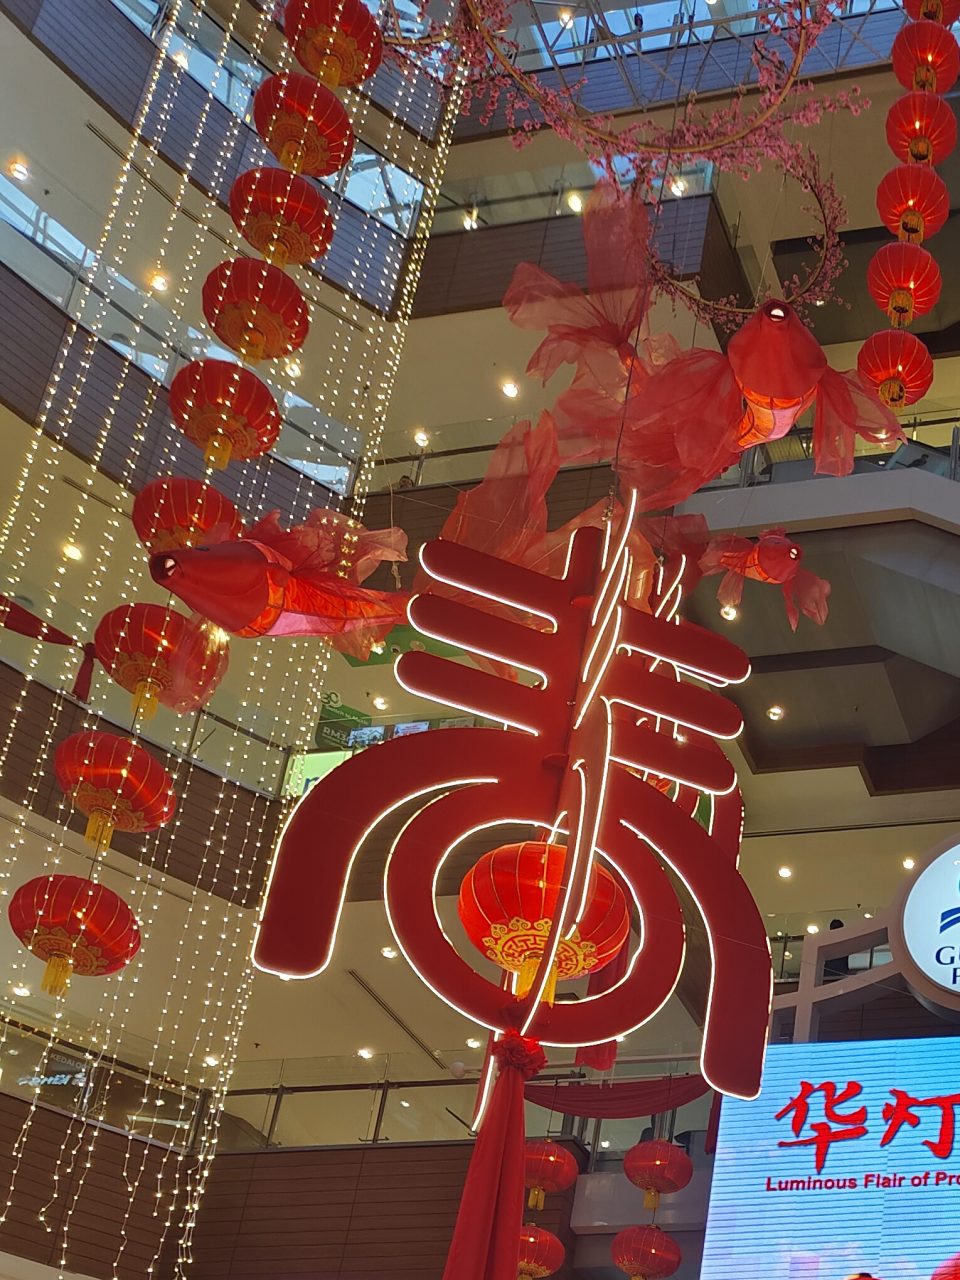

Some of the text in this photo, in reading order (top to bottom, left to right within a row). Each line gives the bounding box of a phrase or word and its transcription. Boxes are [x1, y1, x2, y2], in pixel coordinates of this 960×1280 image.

[766, 1173, 858, 1192] Luminous
[864, 1172, 902, 1189] Flair
[912, 1171, 930, 1187] of
